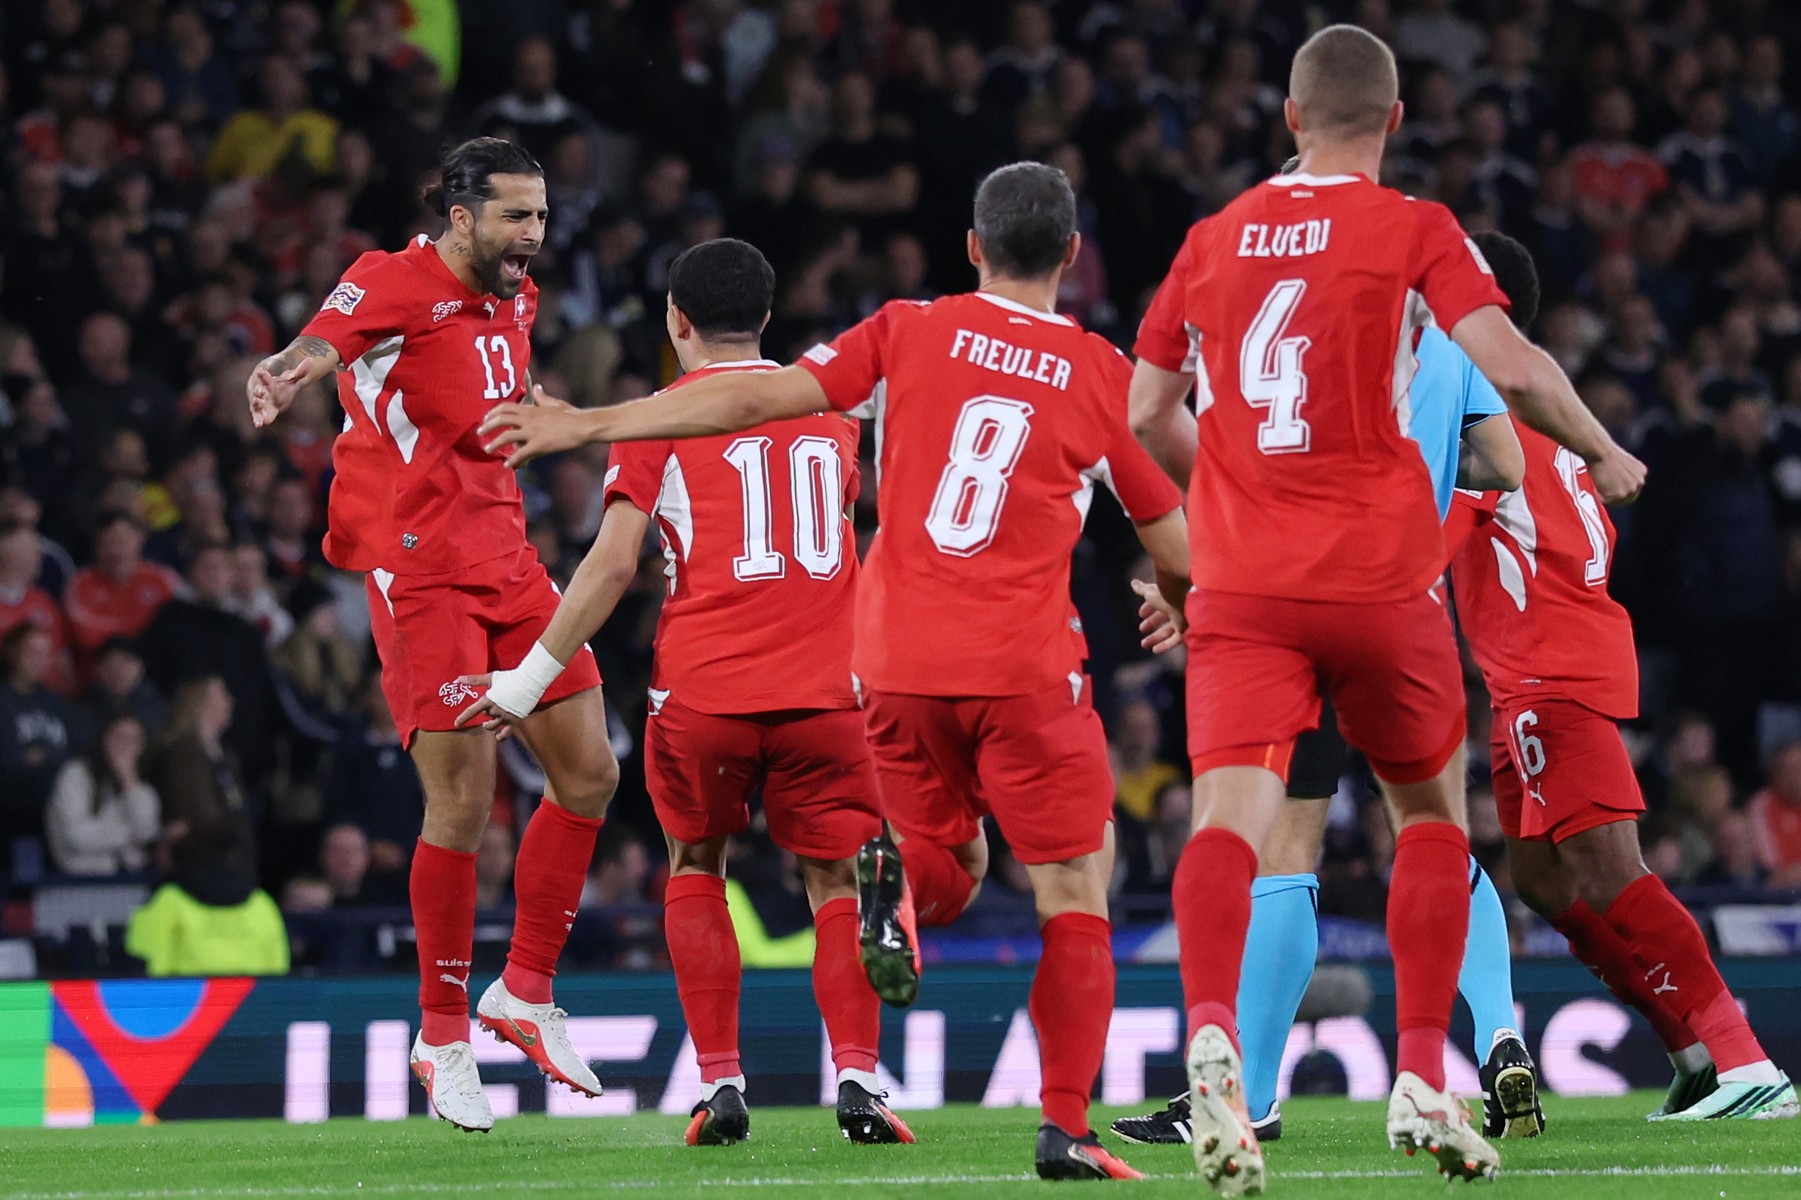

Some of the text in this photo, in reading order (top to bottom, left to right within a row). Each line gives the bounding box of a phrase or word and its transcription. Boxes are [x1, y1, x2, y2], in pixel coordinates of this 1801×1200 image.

[1237, 218, 1331, 257] ELVEDI
[475, 335, 516, 399] 13
[949, 329, 1072, 391] FREULER
[1240, 278, 1312, 455] 4
[722, 435, 842, 582] 10
[925, 394, 1035, 558] 8
[436, 958, 472, 967] suiss
[820, 1000, 1631, 1108] NATOS
